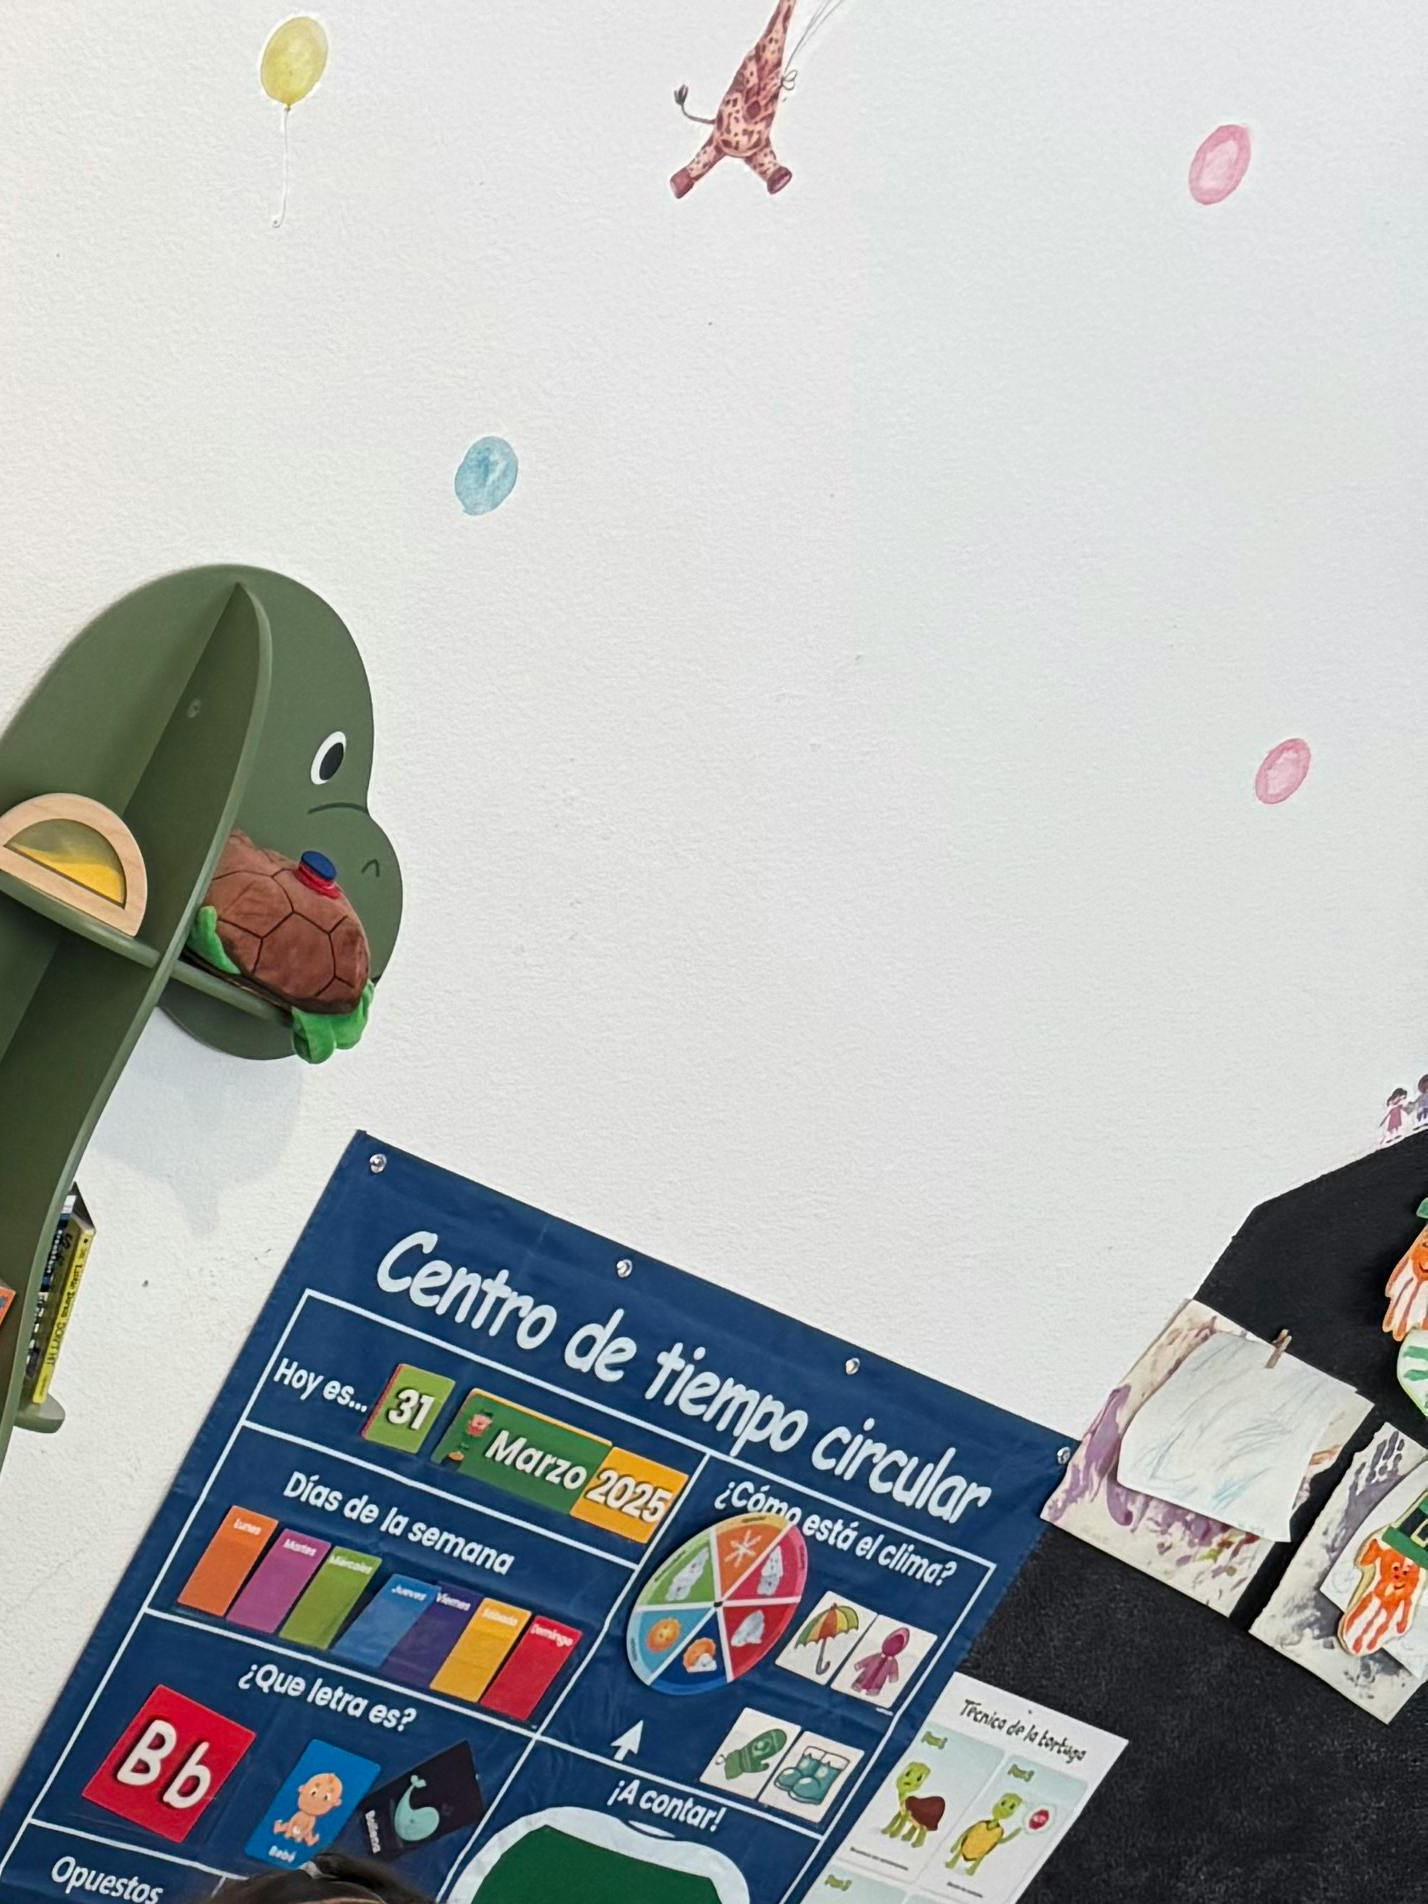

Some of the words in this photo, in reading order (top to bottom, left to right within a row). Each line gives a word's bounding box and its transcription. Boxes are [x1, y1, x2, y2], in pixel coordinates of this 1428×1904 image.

[272, 1357, 324, 1402] Hoy
[324, 1380, 368, 1414] es...
[376, 1230, 556, 1350] Centro
[563, 1309, 637, 1382] de
[645, 1343, 810, 1457] tiempo
[811, 1417, 992, 1526] circular
[384, 1389, 434, 1432] 31
[485, 1430, 589, 1491] Marzo
[587, 1469, 671, 1524] 2025
[233, 1517, 262, 1536] Lunes
[283, 1471, 344, 1513] Días
[343, 1494, 380, 1525] de
[380, 1507, 405, 1537] la
[406, 1521, 515, 1576] semana
[283, 1538, 317, 1557] Martes
[713, 1481, 803, 1531] ¿Cómo
[803, 1513, 857, 1551] está
[856, 1531, 879, 1560] el
[879, 1540, 957, 1587] clima?
[391, 1584, 427, 1602] Jueves
[436, 1591, 471, 1612] Viernes
[529, 1623, 574, 1648] Domingo
[238, 1663, 306, 1696] ¿Que
[306, 1673, 364, 1716] letra
[367, 1702, 417, 1733] es?
[1006, 1719, 1025, 1737] de
[1026, 1724, 1039, 1742] la
[1039, 1732, 1087, 1764] tortuga
[607, 1779, 642, 1809] ¡A
[639, 1789, 727, 1832] contar!
